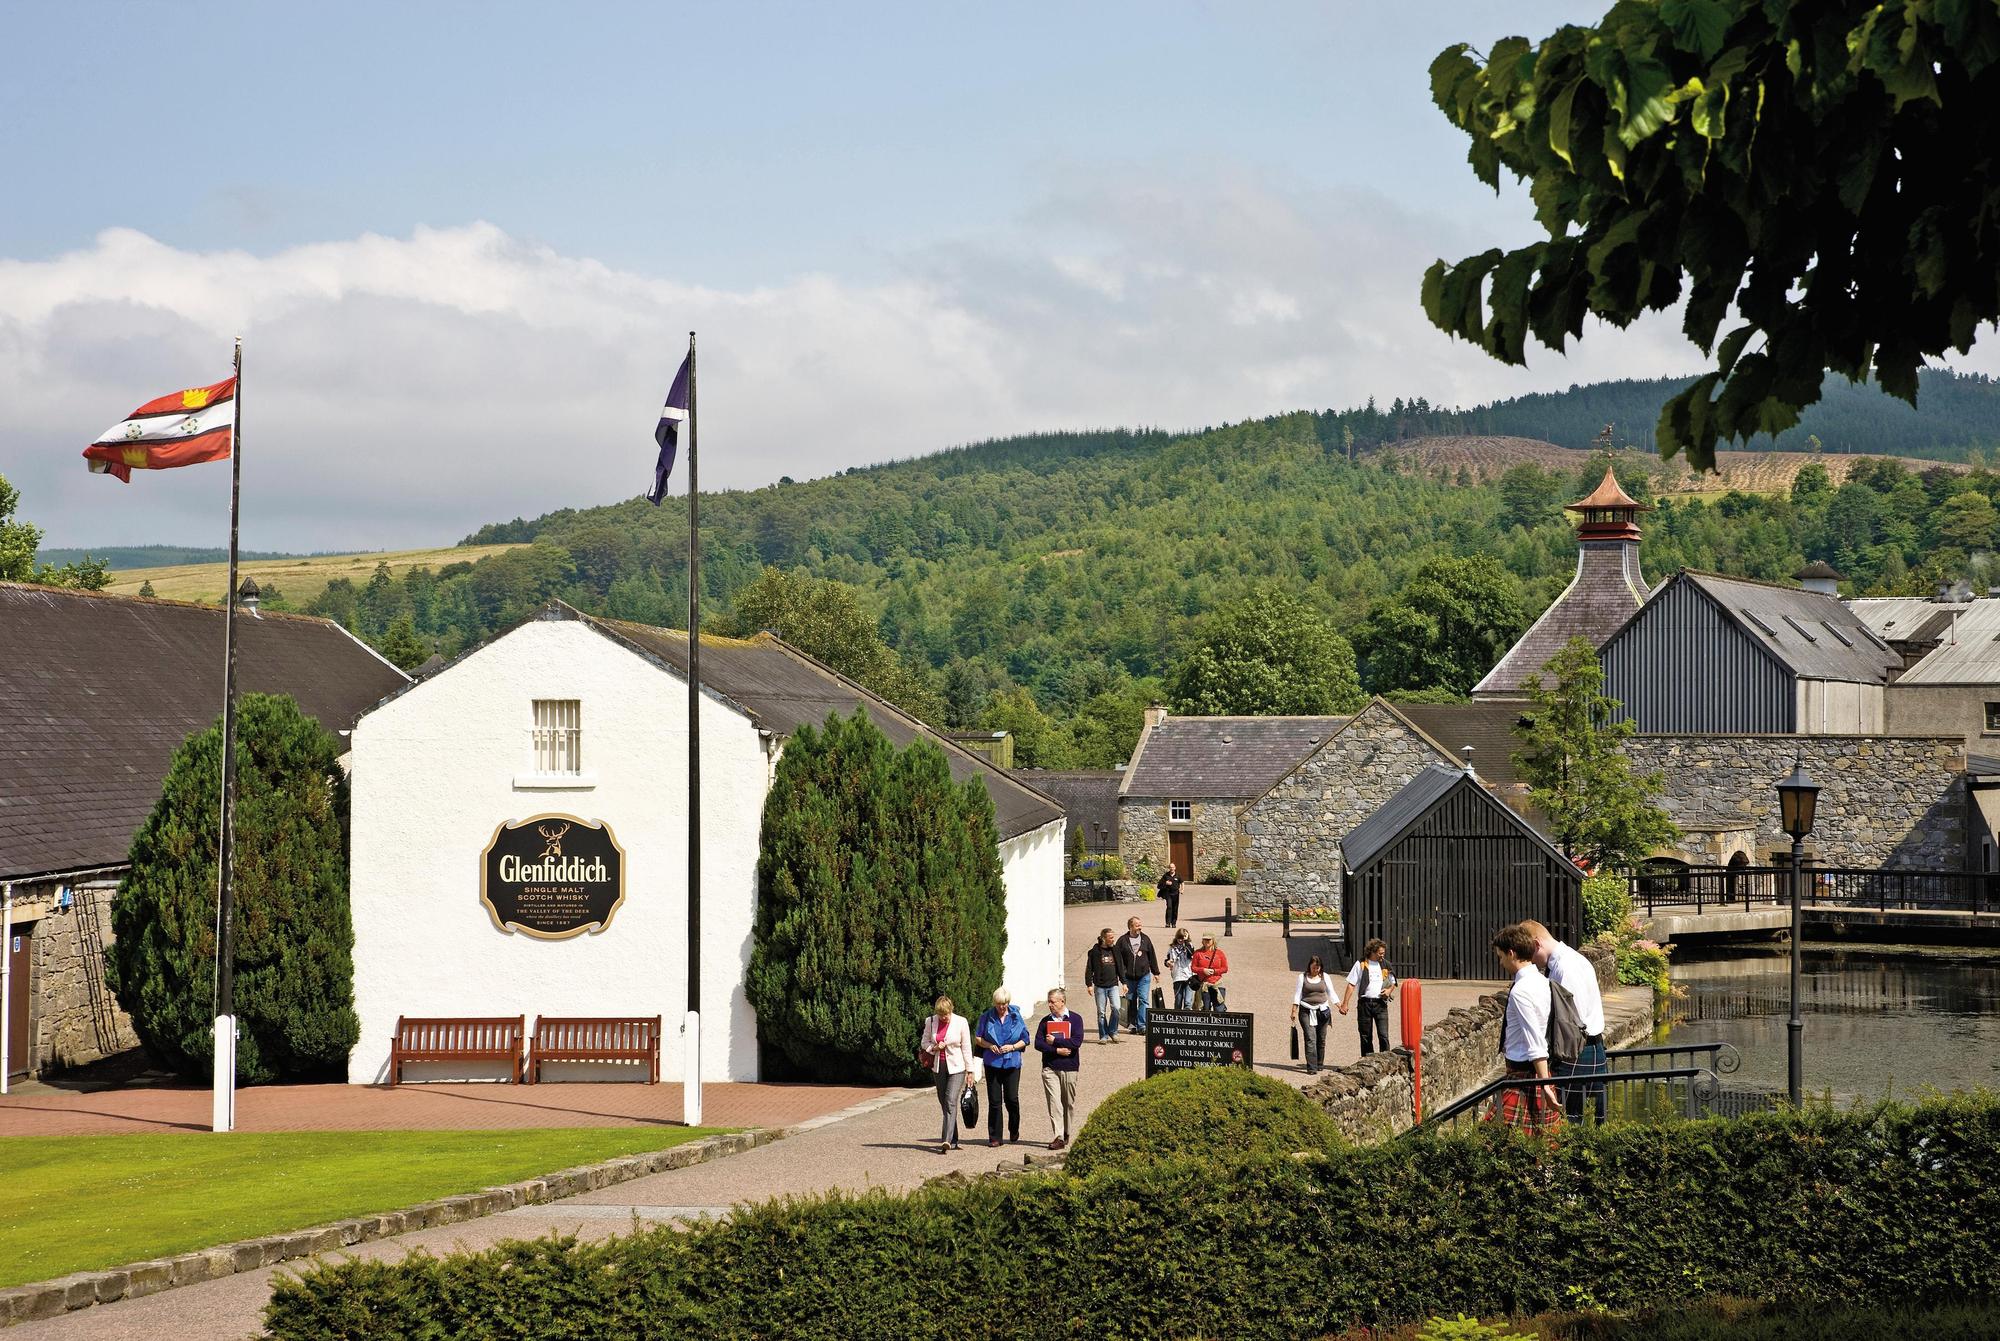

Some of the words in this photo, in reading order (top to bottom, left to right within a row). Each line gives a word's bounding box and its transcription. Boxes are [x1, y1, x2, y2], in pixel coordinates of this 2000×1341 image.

[500, 854, 607, 883] Glenfiddich
[1211, 1016, 1248, 1025] DISTILLERY
[1177, 1028, 1208, 1036] INTEREST
